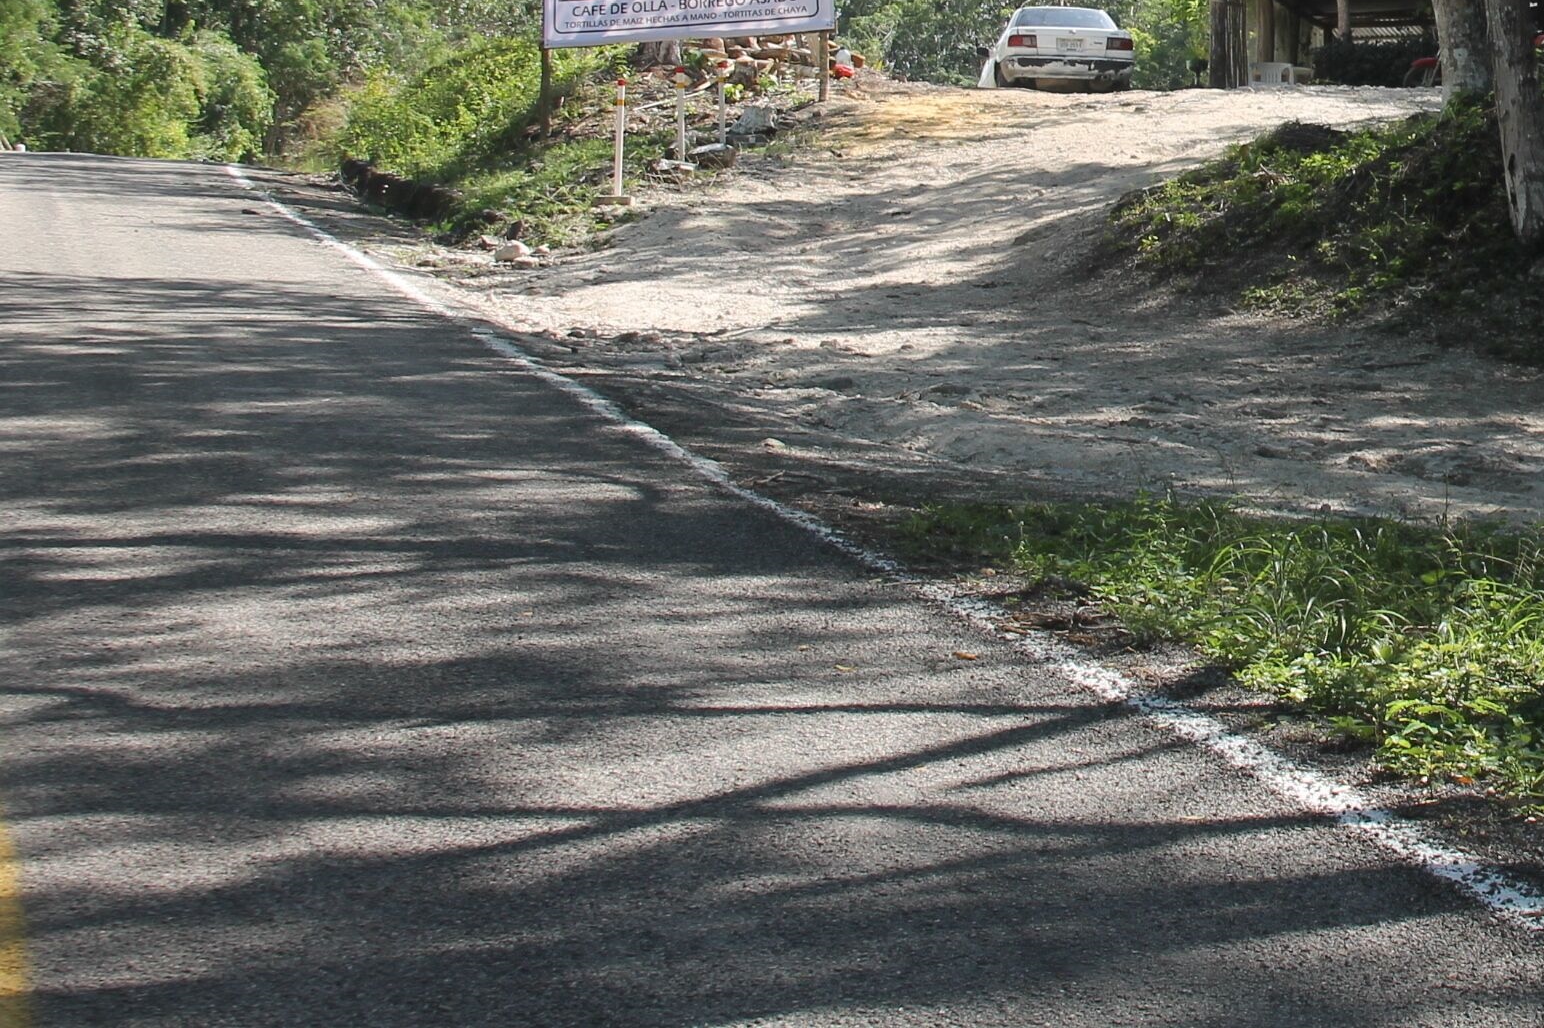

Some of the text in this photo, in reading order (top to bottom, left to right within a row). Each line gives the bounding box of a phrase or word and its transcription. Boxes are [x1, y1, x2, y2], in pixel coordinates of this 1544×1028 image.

[565, 19, 608, 29] TORTILLAS
[609, 19, 621, 27] DE
[623, 17, 644, 25] MAIZ
[646, 14, 680, 24] HECHAS
[690, 12, 717, 20] MANO
[723, 9, 762, 19] TORTITAS
[765, 8, 776, 16] DE
[778, 5, 807, 15] CHAYA
[572, 4, 606, 17] CAFE
[610, 2, 628, 15] DE
[632, 0, 667, 13] OLLA
